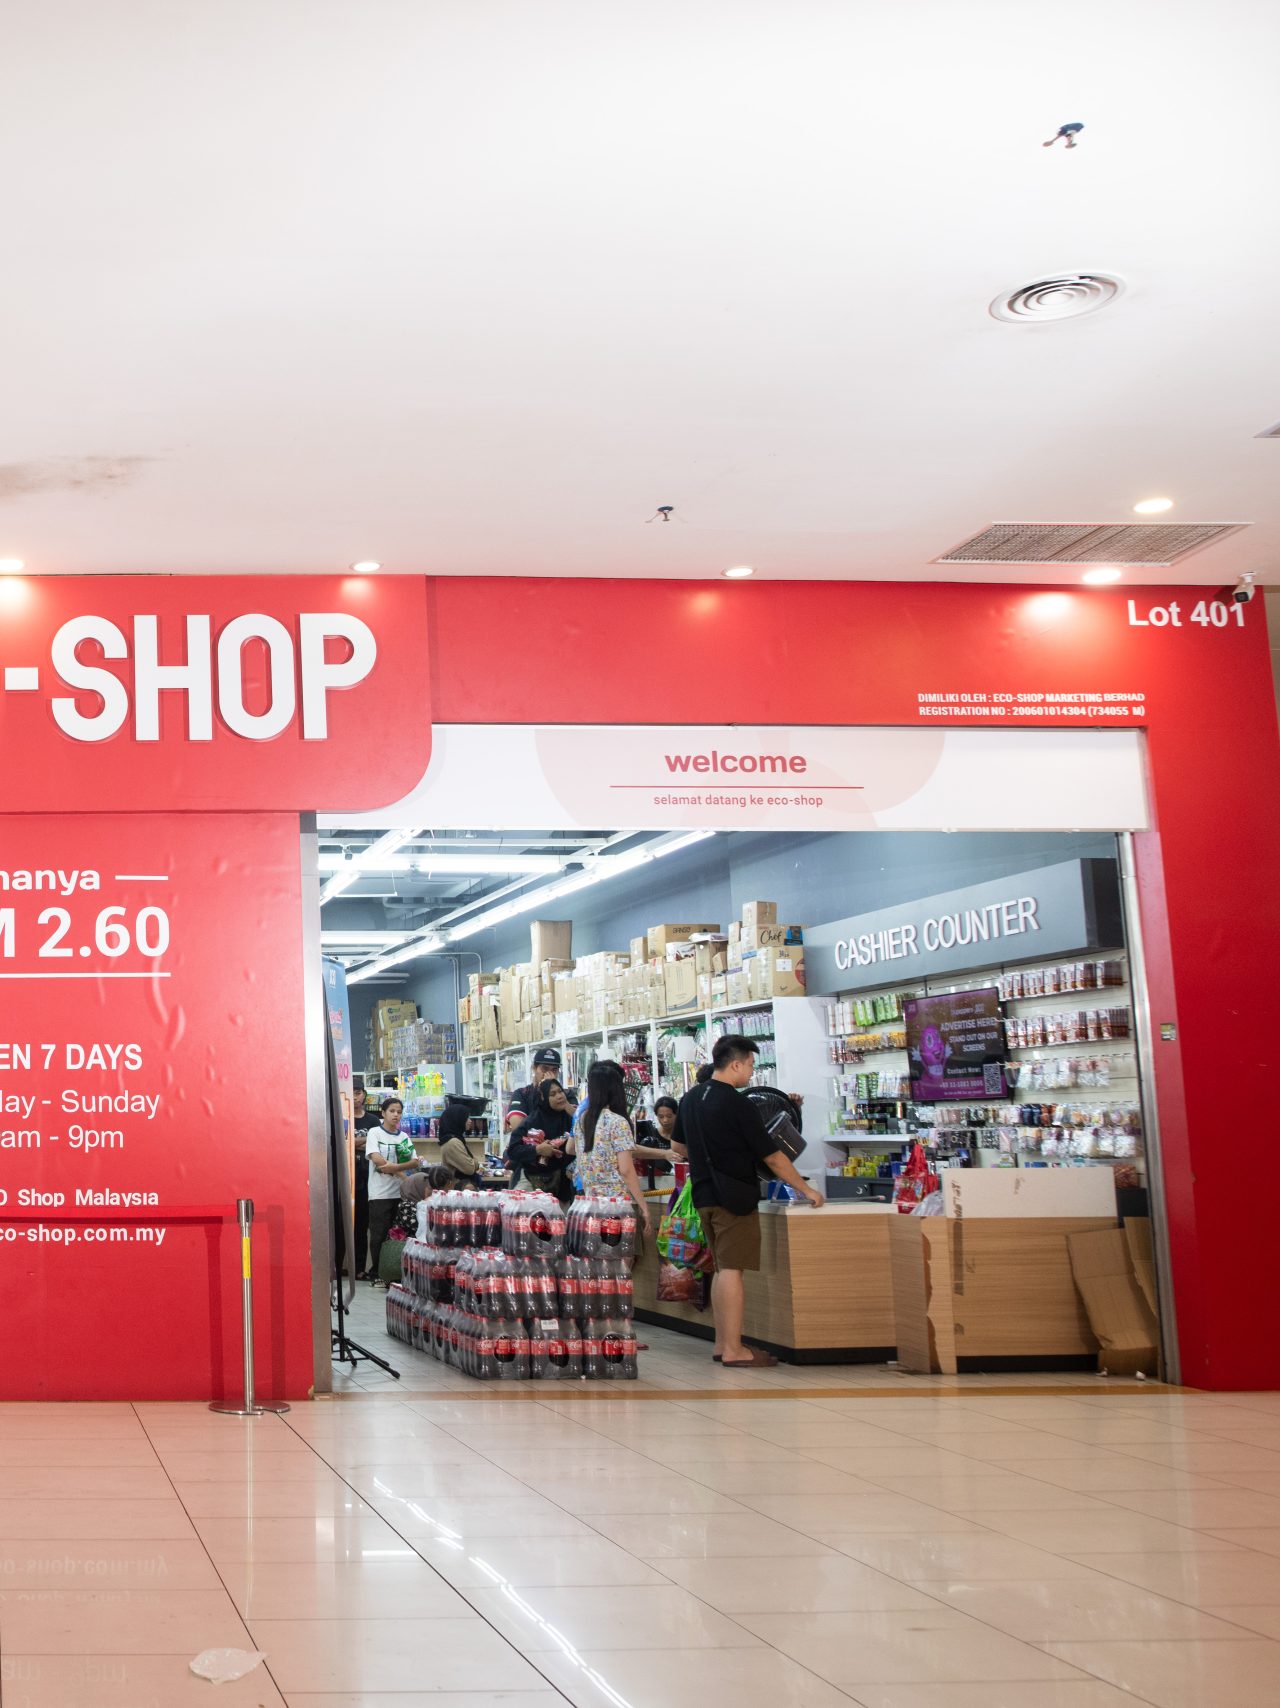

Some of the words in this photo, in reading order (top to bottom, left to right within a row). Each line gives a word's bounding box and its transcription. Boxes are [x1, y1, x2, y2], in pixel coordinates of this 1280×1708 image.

[1127, 600, 1182, 626] Lot
[1190, 601, 1245, 627] 401
[918, 693, 959, 703] DIMILIKI
[961, 693, 987, 703] OLEH
[993, 693, 1044, 703] ECO-SHOP
[1045, 693, 1102, 703] MARKETING
[1104, 693, 1145, 702] BERHAD
[919, 706, 990, 716] REGISTRATION
[991, 706, 1005, 716] NO
[665, 751, 807, 773] welcome
[654, 795, 702, 805] selamat
[705, 794, 746, 807] datang
[750, 795, 764, 805] ke
[767, 795, 823, 807] eco-shop
[37, 905, 169, 957] 2.60
[834, 924, 920, 970] CASHIER
[923, 896, 1041, 952] COUNTER
[41, 1044, 56, 1070] 7
[66, 1043, 143, 1070] DAYS
[61, 1089, 160, 1119] Sunday
[68, 1125, 124, 1153] 9pm
[18, 1188, 65, 1207] Shop
[75, 1188, 159, 1207] Malaysia
